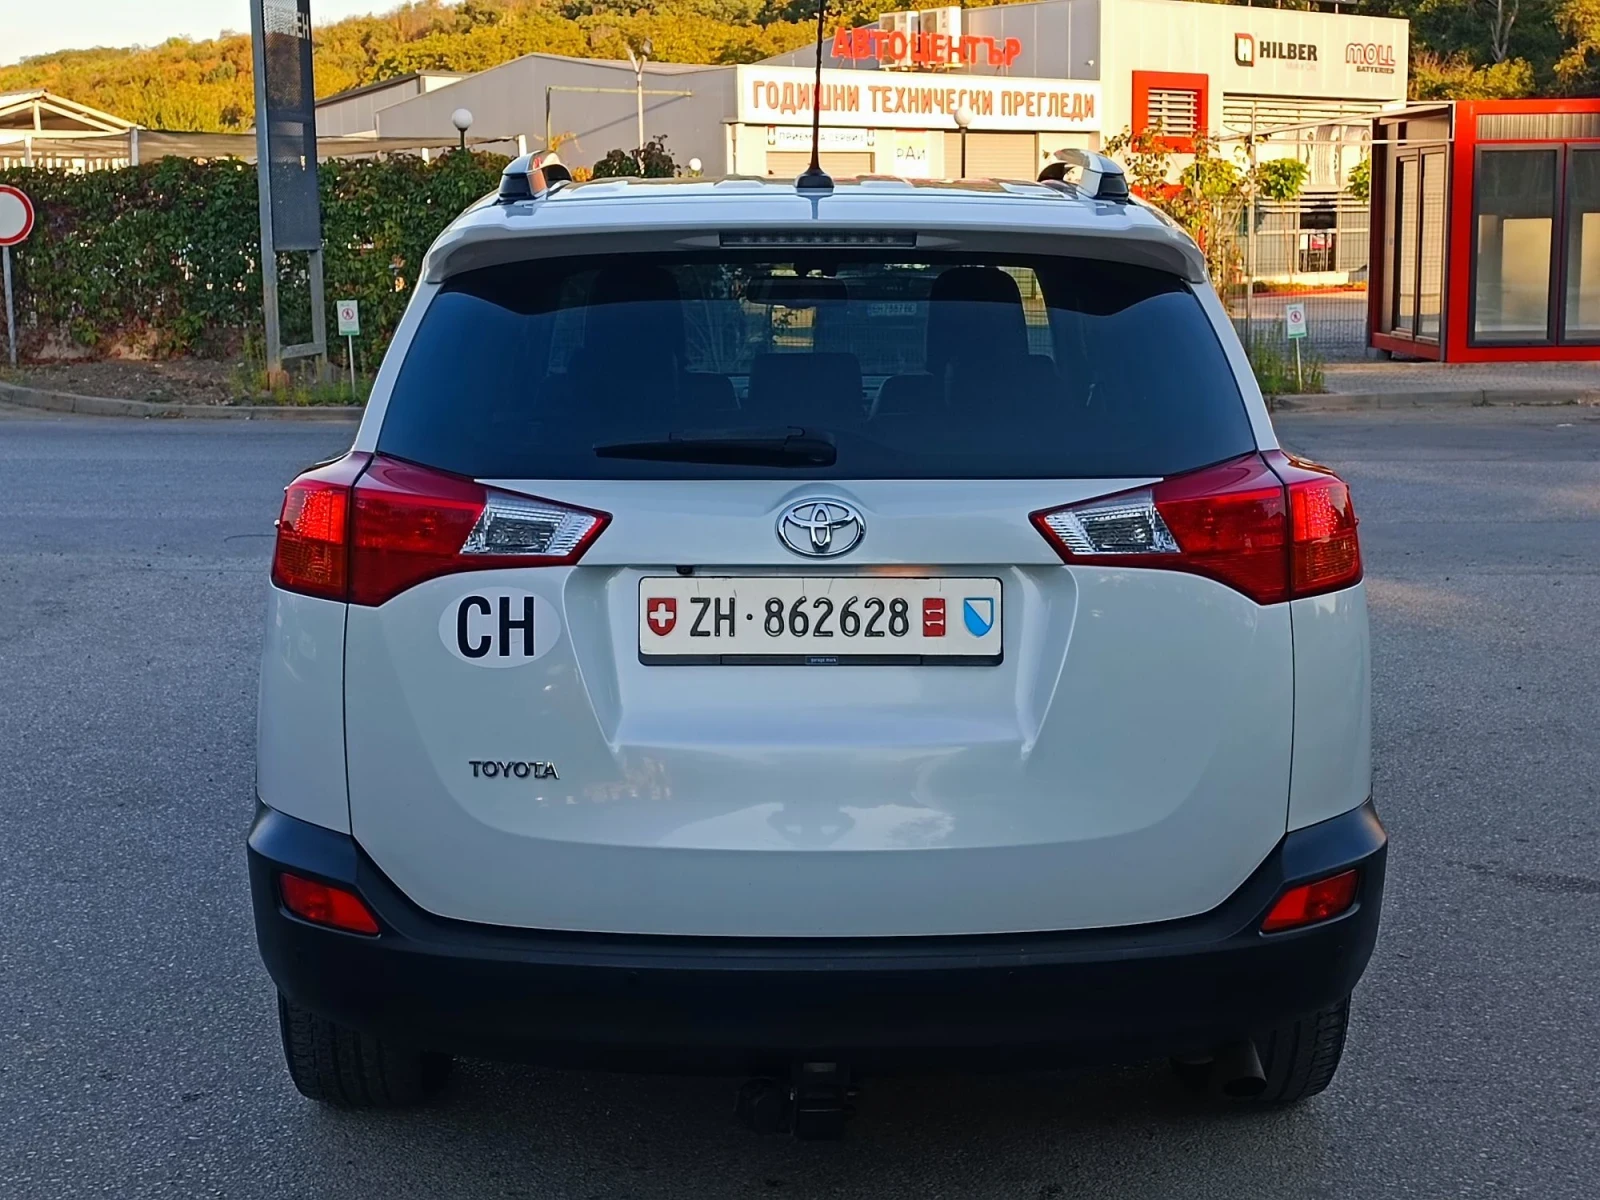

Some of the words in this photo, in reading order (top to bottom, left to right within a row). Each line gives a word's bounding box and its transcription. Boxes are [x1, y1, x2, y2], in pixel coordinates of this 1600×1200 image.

[830, 27, 1022, 67] АВТОЦЕНТЪР
[1259, 41, 1318, 62] HILBER
[752, 80, 861, 115] ГОДИШНИ
[1000, 90, 1095, 122] ПРЕГЛЕДИ
[456, 595, 535, 659] CH
[468, 760, 560, 780] TOYOTA
